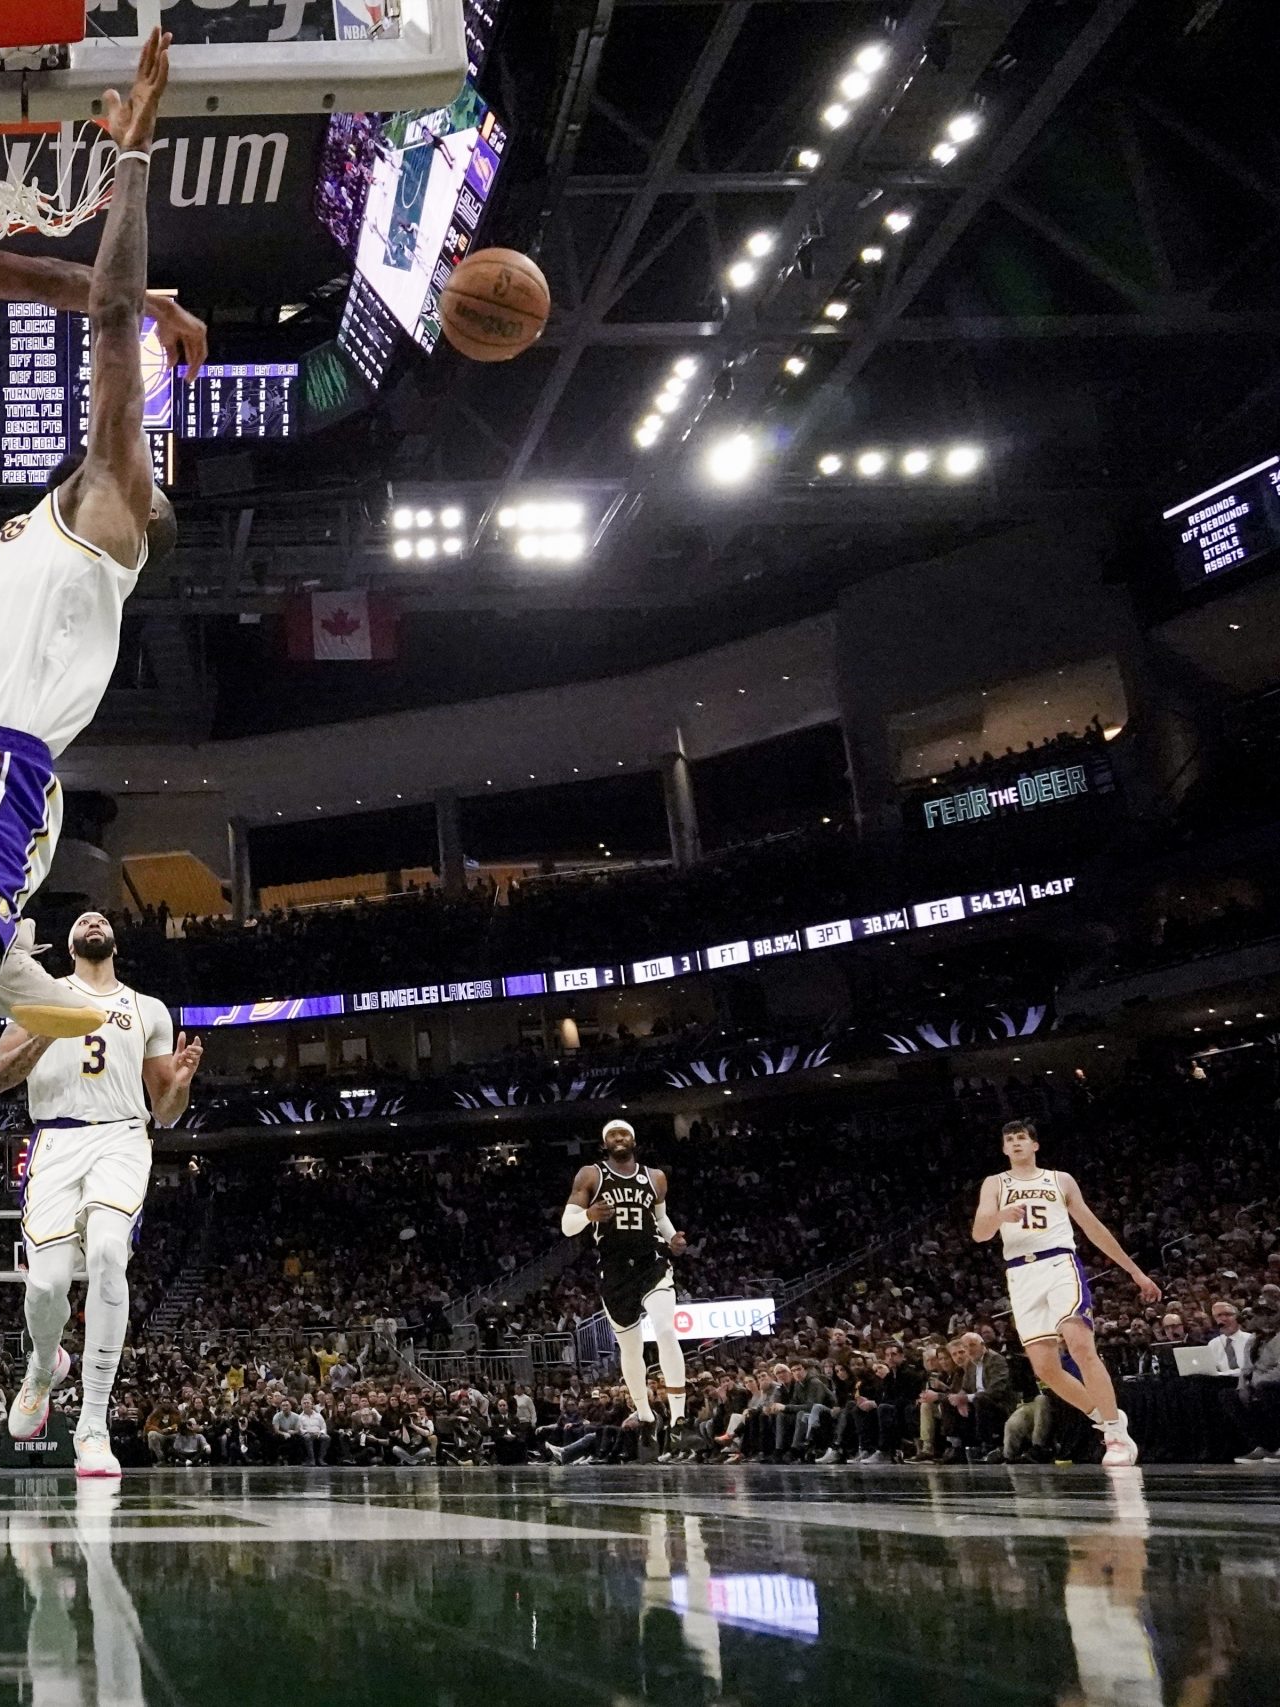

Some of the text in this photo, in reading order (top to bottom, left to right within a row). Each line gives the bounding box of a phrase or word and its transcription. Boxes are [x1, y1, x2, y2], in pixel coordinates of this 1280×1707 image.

[344, 25, 367, 39] NBA
[8, 303, 57, 316] ASSISTS
[10, 320, 55, 334] BLOCKS
[10, 337, 54, 350] STEALS
[9, 354, 31, 367] OFF
[34, 354, 56, 367] REB
[10, 371, 31, 384] DEF
[34, 370, 56, 384] REB
[208, 365, 224, 376] PTS
[210, 379, 221, 389] 34
[236, 378, 242, 388] 5
[260, 378, 266, 388] 3
[283, 378, 290, 388] 2
[3, 387, 64, 400] TURNOVERS
[189, 391, 195, 401] 4
[211, 391, 220, 401] 14
[236, 390, 242, 400] 2
[5, 404, 39, 417] TOTAL
[41, 404, 62, 416] FLS
[236, 402, 242, 412] 7
[188, 415, 196, 425] 15
[212, 415, 218, 425] 7
[236, 414, 242, 424] 2
[5, 421, 39, 434] BENCH
[41, 420, 62, 433] PTS
[187, 426, 288, 437] 21 7 3 2 2
[2, 437, 31, 450] FIELD
[32, 437, 65, 450] GOALS
[4, 453, 63, 466] 3-POINTERS
[2, 470, 26, 483] FREE
[27, 470, 50, 483] THR
[1188, 495, 1236, 526] REBOUNDS
[1181, 502, 1249, 543] OFF REBOUNDS
[1200, 523, 1236, 548] BLOCKS
[1203, 536, 1239, 560] STEALS
[1204, 548, 1244, 574] ASSISTS
[924, 765, 1088, 828] FEAR THE DEER
[1031, 877, 1076, 900] 8:43 P
[564, 888, 1021, 987] FLS 2 TOL 3 FT 88.9% 3PT 38.1% FG 54.3%
[354, 980, 492, 1011] LOS ANGELES LAKERS
[82, 1035, 106, 1075] 3
[602, 1188, 654, 1209] BUCKS
[1005, 1189, 1056, 1205] LAKERS
[616, 1207, 642, 1230] 23
[1022, 1205, 1047, 1229] 15
[708, 1309, 763, 1329] CLUB
[15, 1442, 58, 1451] GET THE NEW APP
